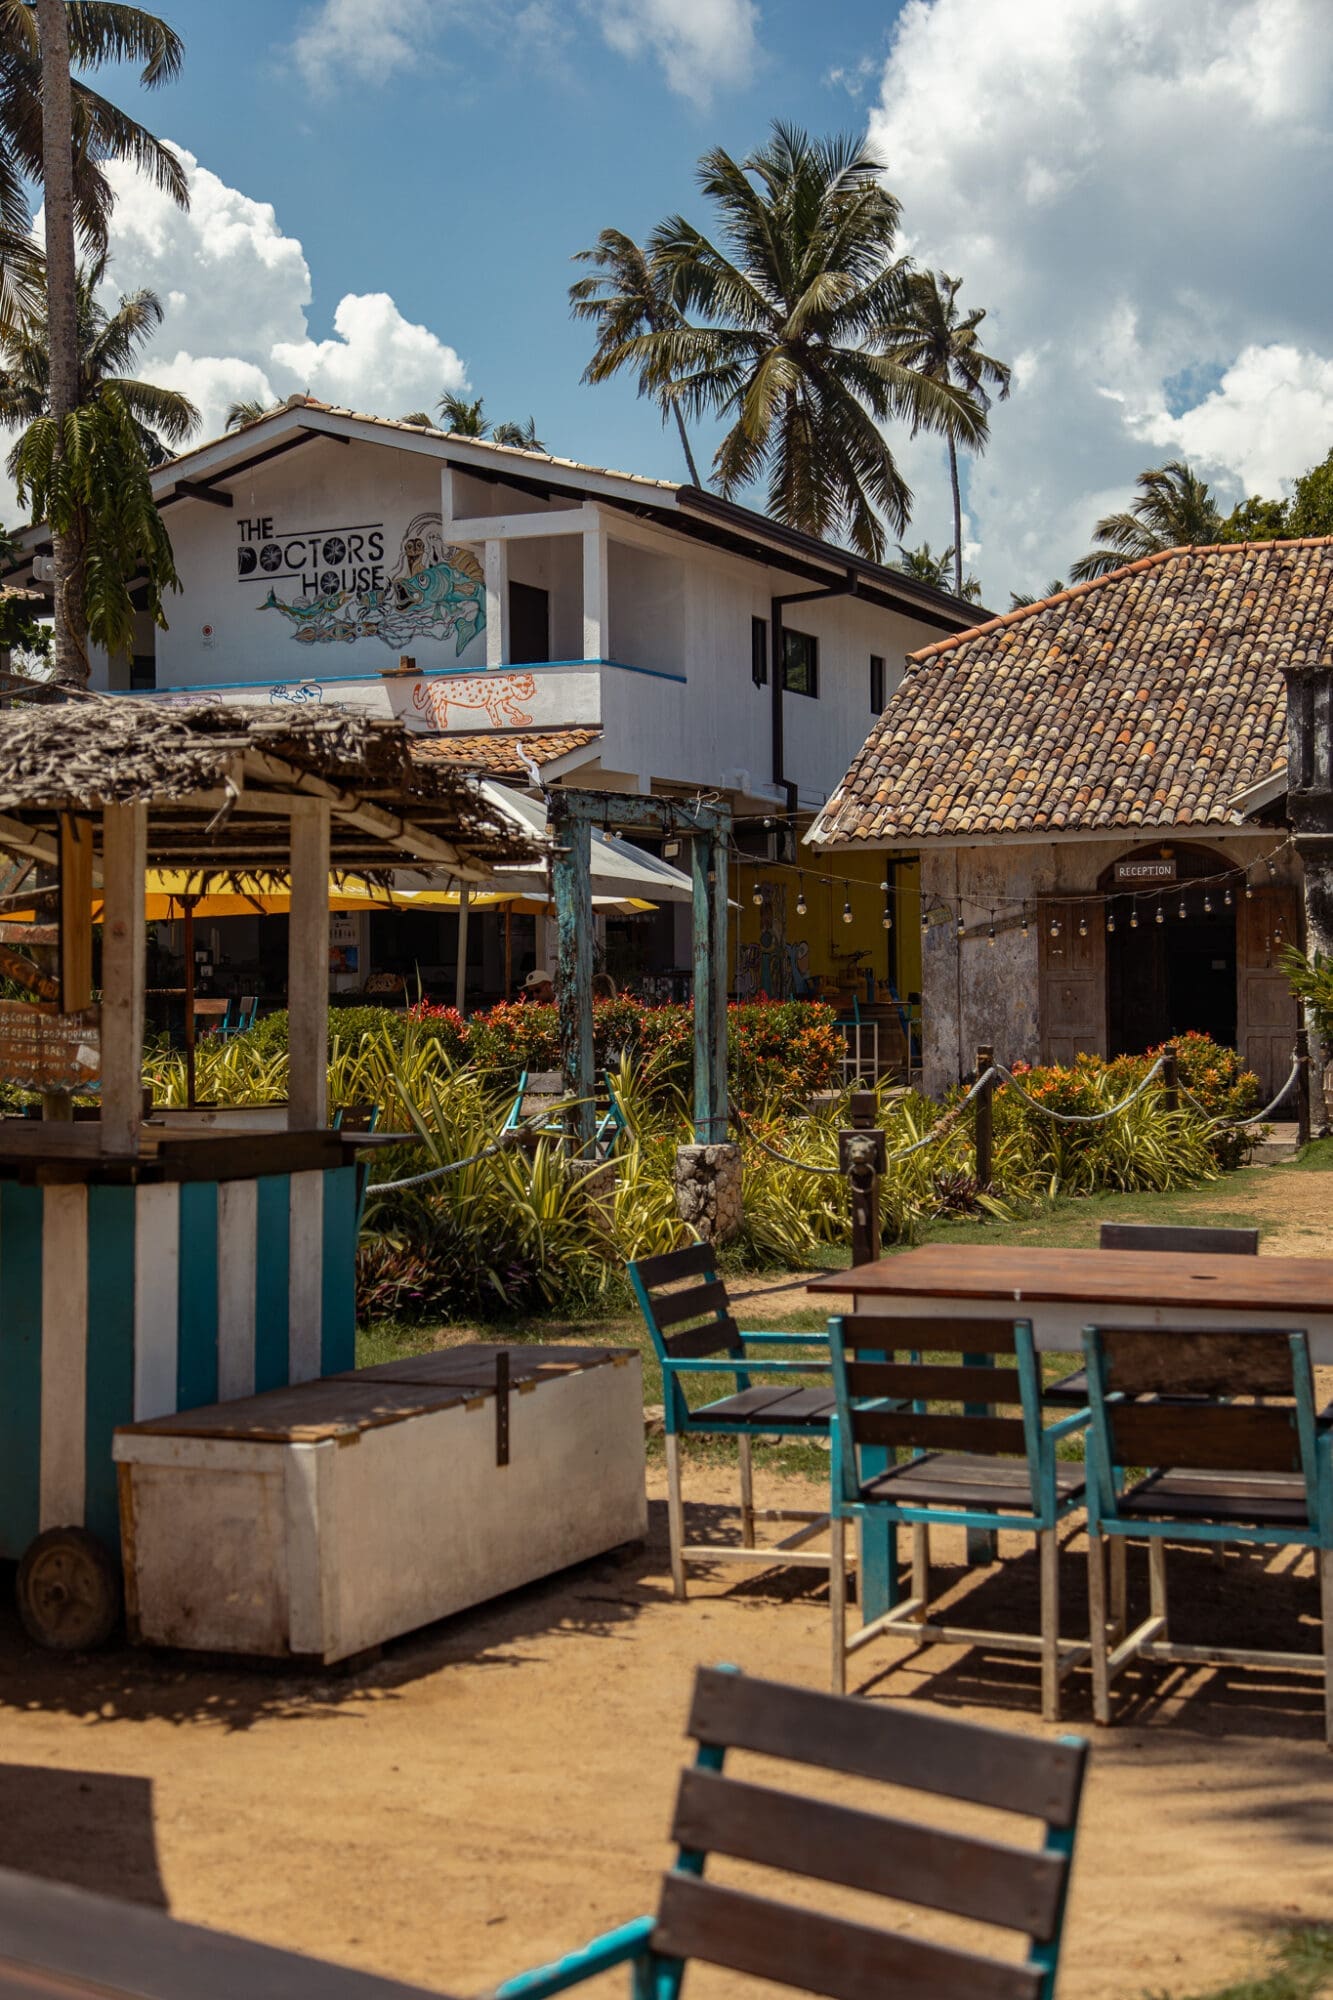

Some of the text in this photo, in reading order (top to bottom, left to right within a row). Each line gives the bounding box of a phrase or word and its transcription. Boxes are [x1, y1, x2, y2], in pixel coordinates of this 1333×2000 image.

[237, 517, 273, 542] THE
[237, 532, 384, 576] DOCTORS
[302, 565, 384, 596] HOUSE
[1119, 865, 1172, 877] RECEPTION
